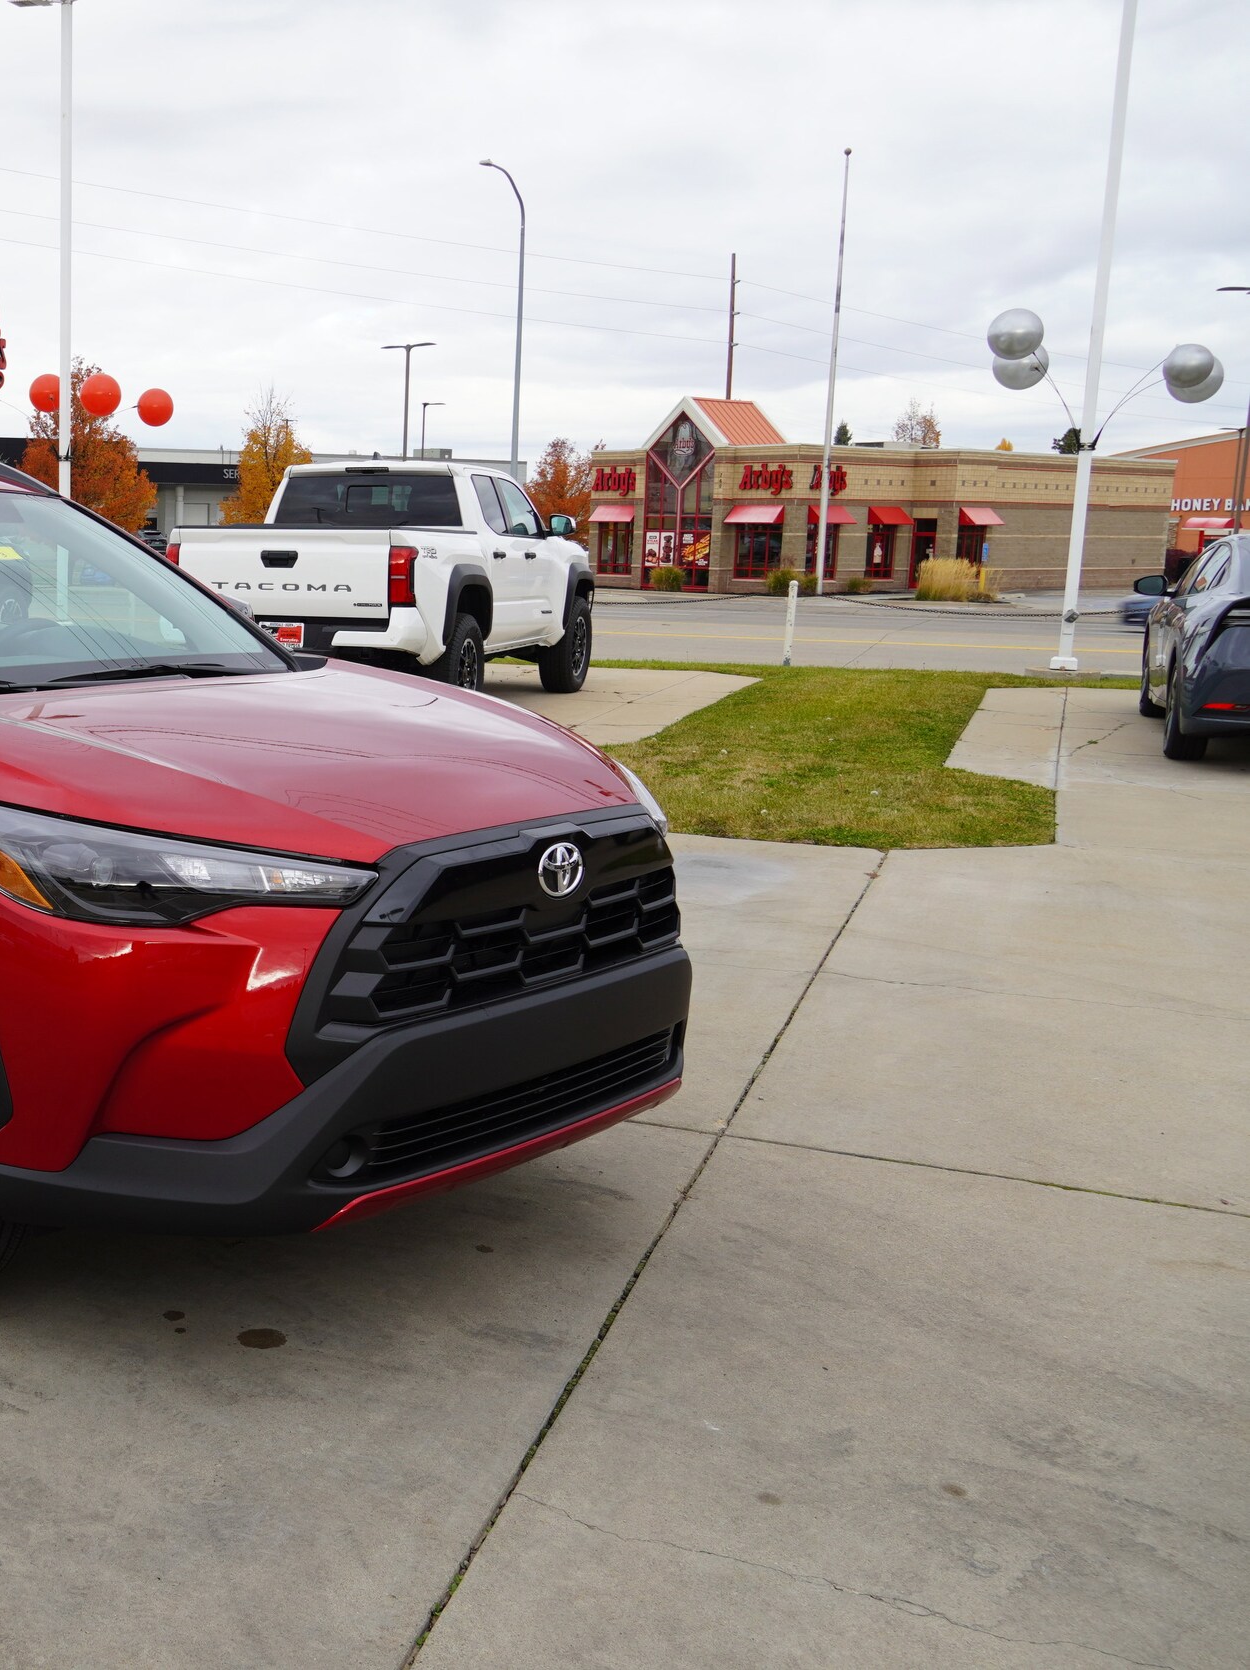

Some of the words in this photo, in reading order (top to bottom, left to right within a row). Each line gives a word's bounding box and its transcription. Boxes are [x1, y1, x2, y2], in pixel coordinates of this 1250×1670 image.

[592, 466, 636, 497] Arby's
[738, 463, 793, 496] Arby's
[1171, 498, 1221, 511] HONEY
[211, 581, 352, 593] TACOMA
